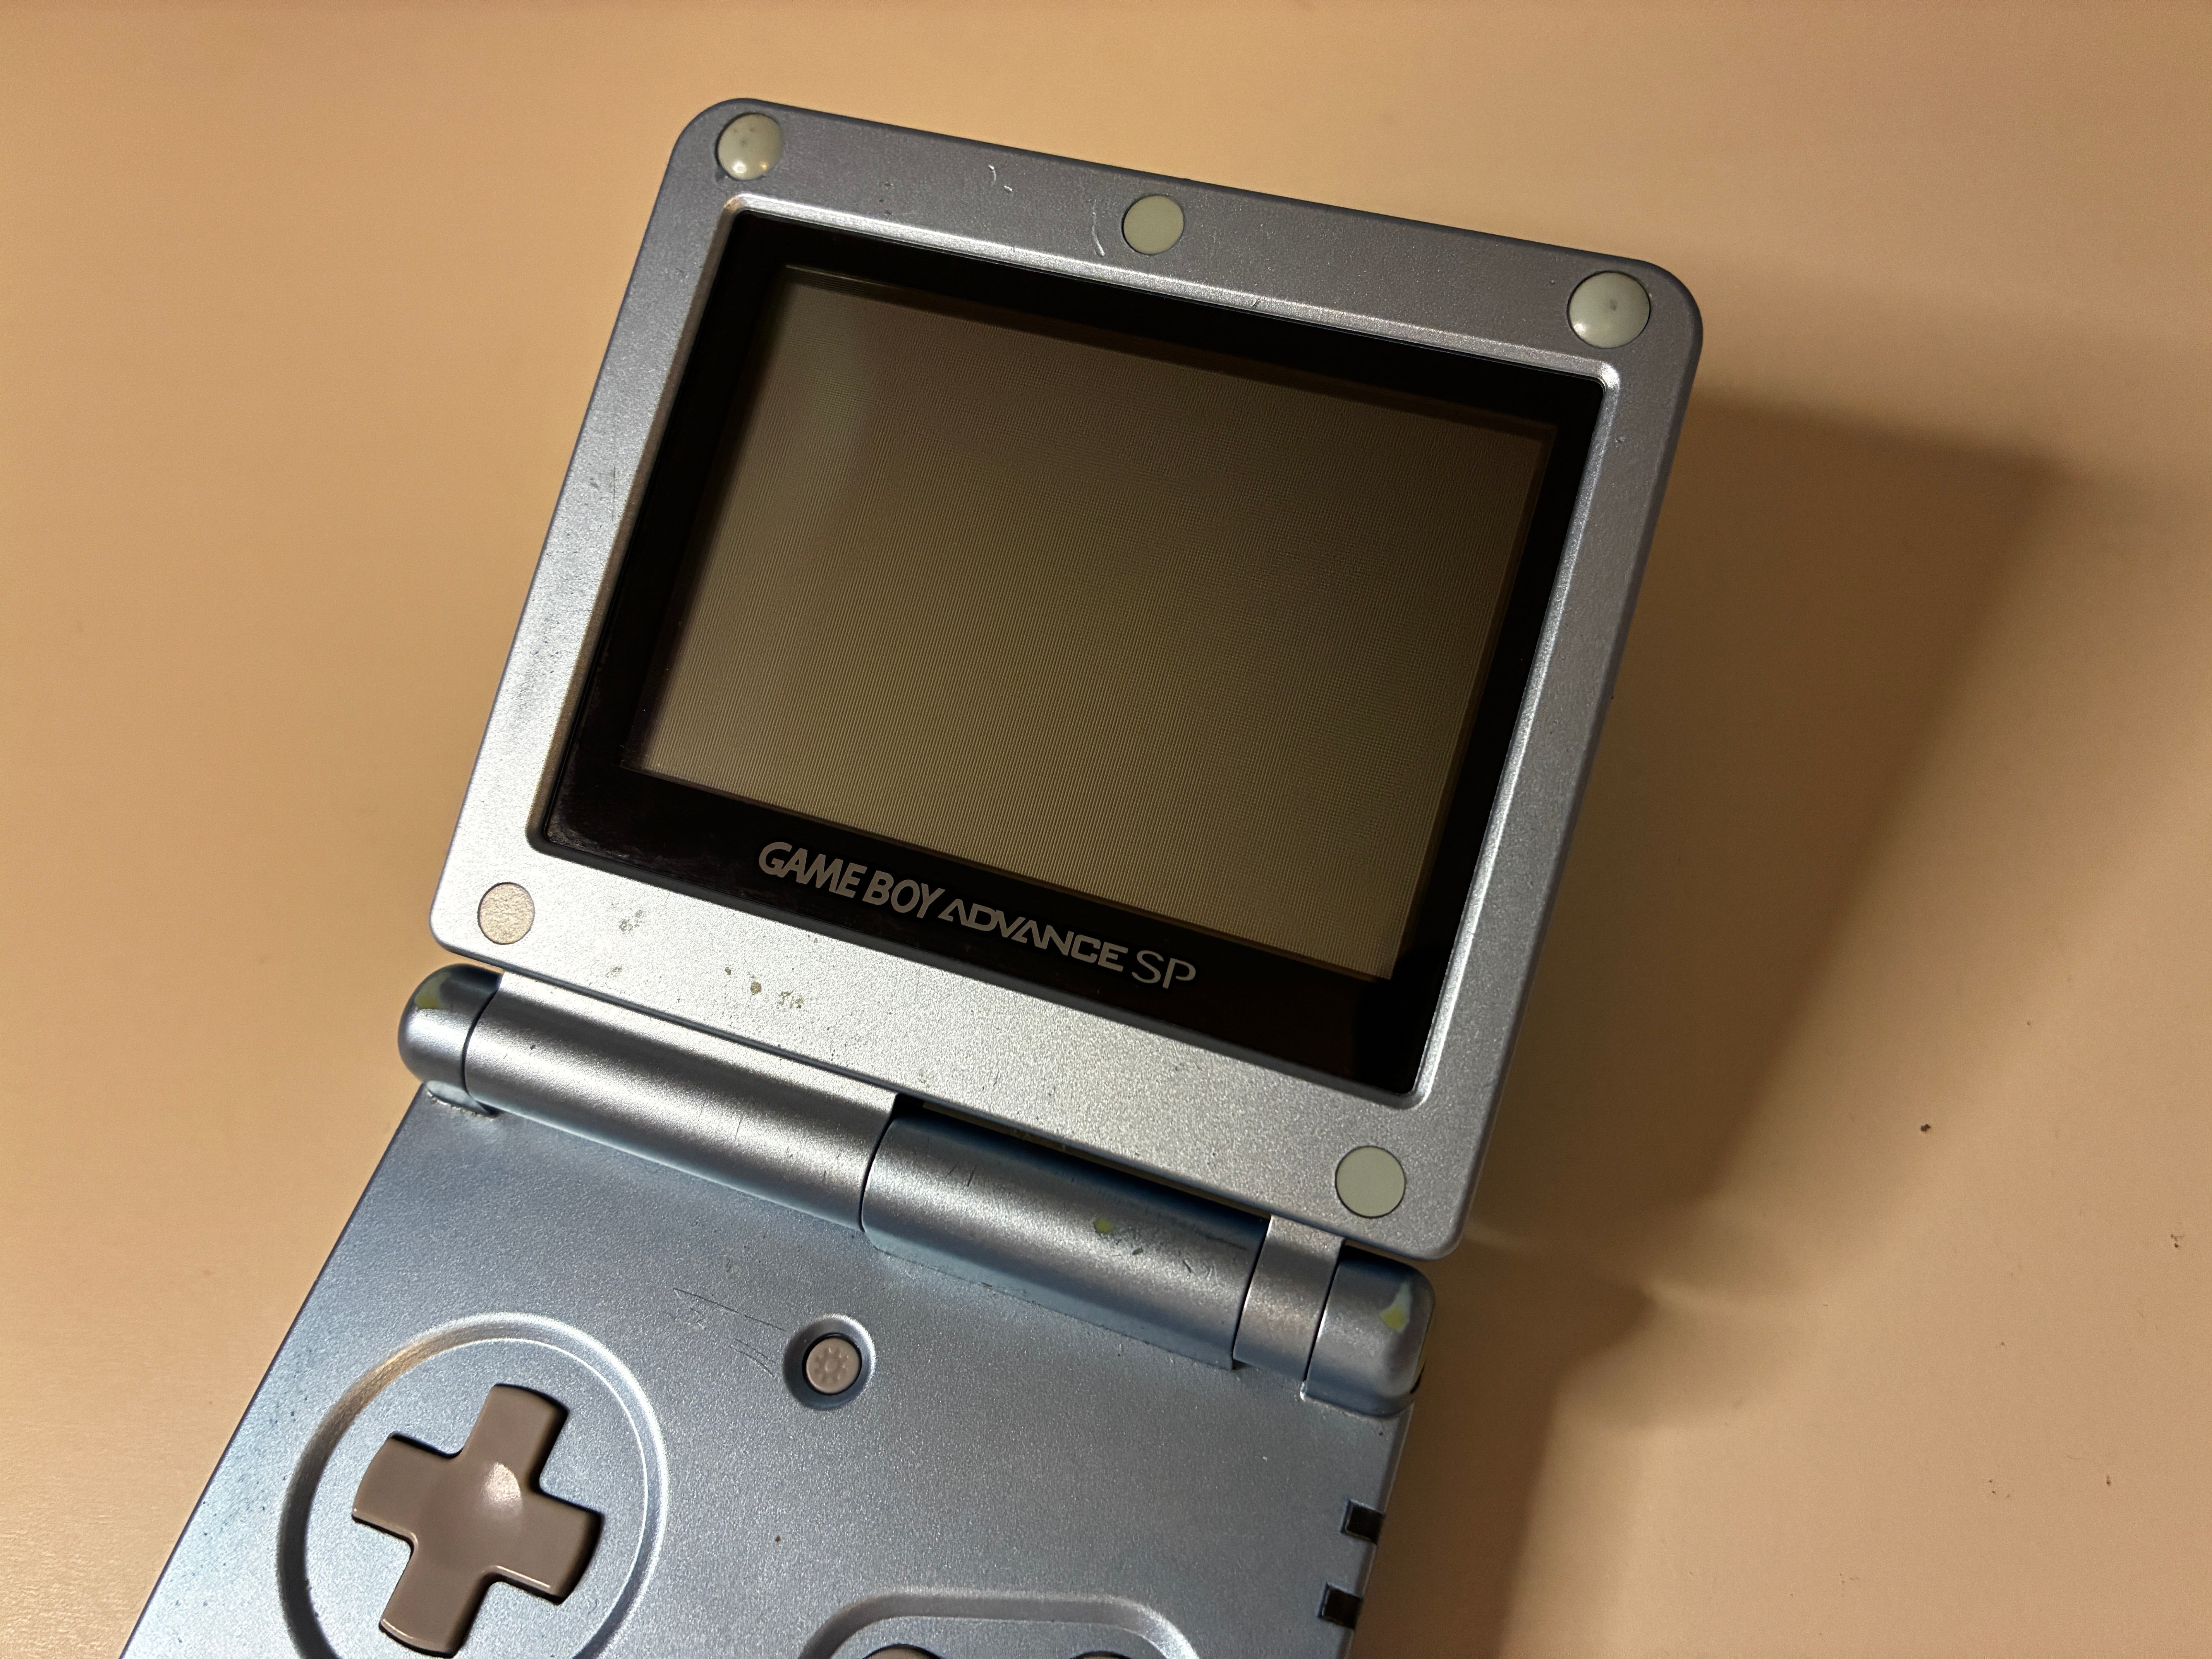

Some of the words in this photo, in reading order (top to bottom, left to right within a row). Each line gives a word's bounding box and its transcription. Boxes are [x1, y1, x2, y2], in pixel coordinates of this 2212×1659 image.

[758, 841, 868, 898] GAME
[862, 869, 946, 919] BOY
[937, 898, 1128, 972] ADVANCE
[1131, 950, 1196, 989] SP
